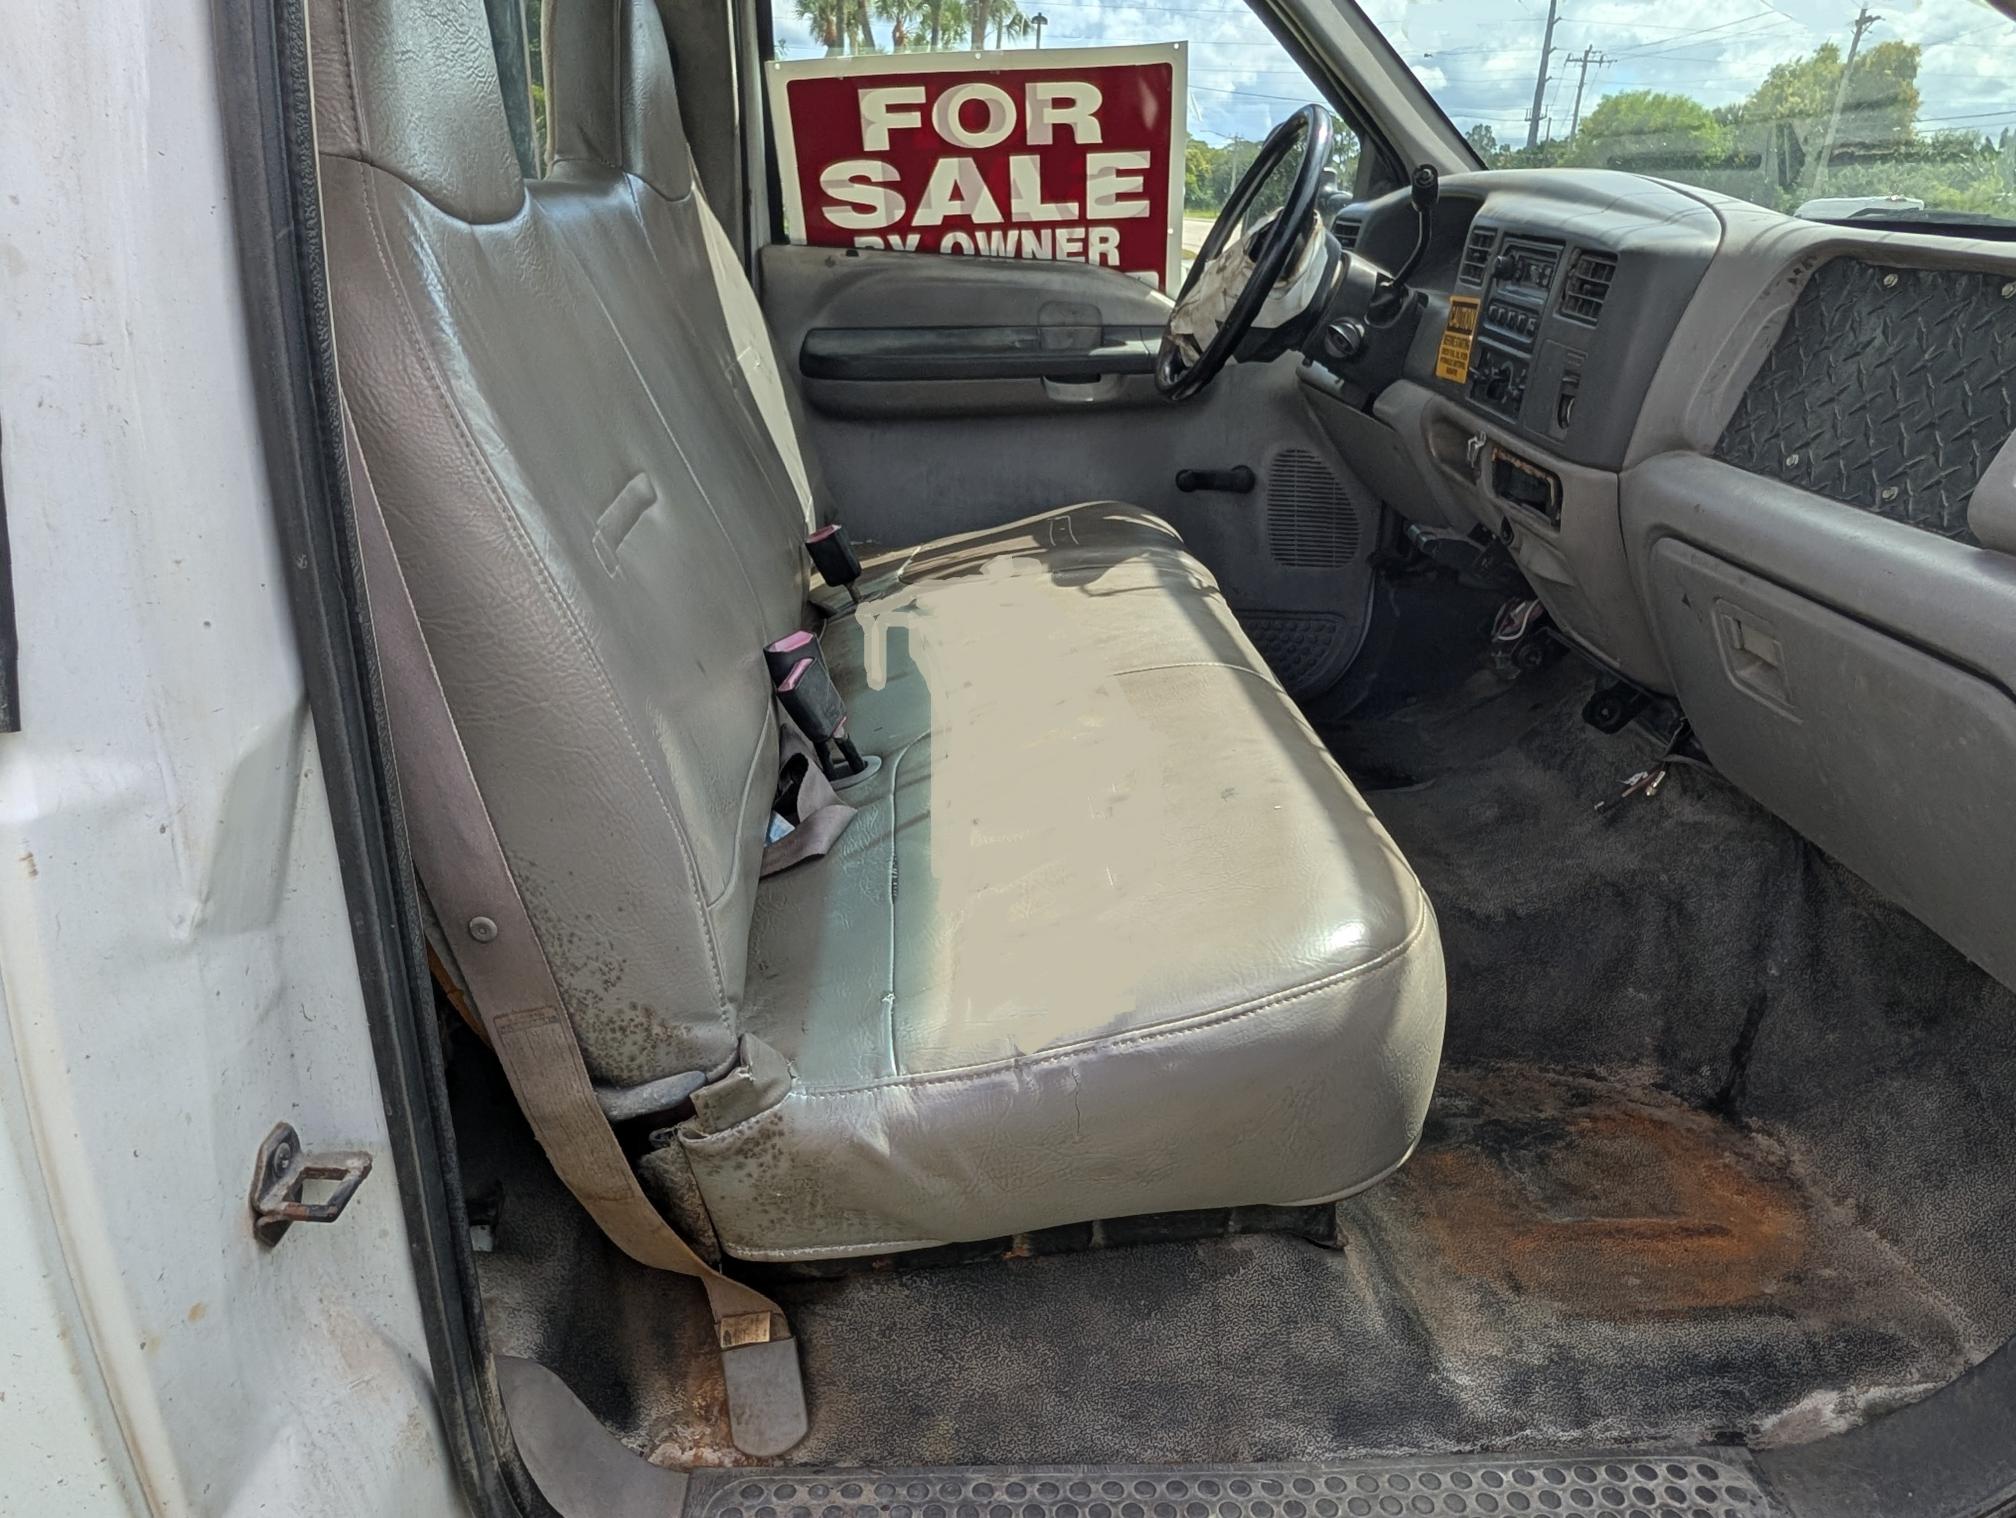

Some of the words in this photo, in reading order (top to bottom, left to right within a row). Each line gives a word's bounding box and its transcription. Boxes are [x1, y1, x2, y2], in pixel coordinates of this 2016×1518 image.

[858, 82, 1103, 152] FOR
[820, 151, 1151, 230] SALE
[939, 227, 1121, 266] OWNER
